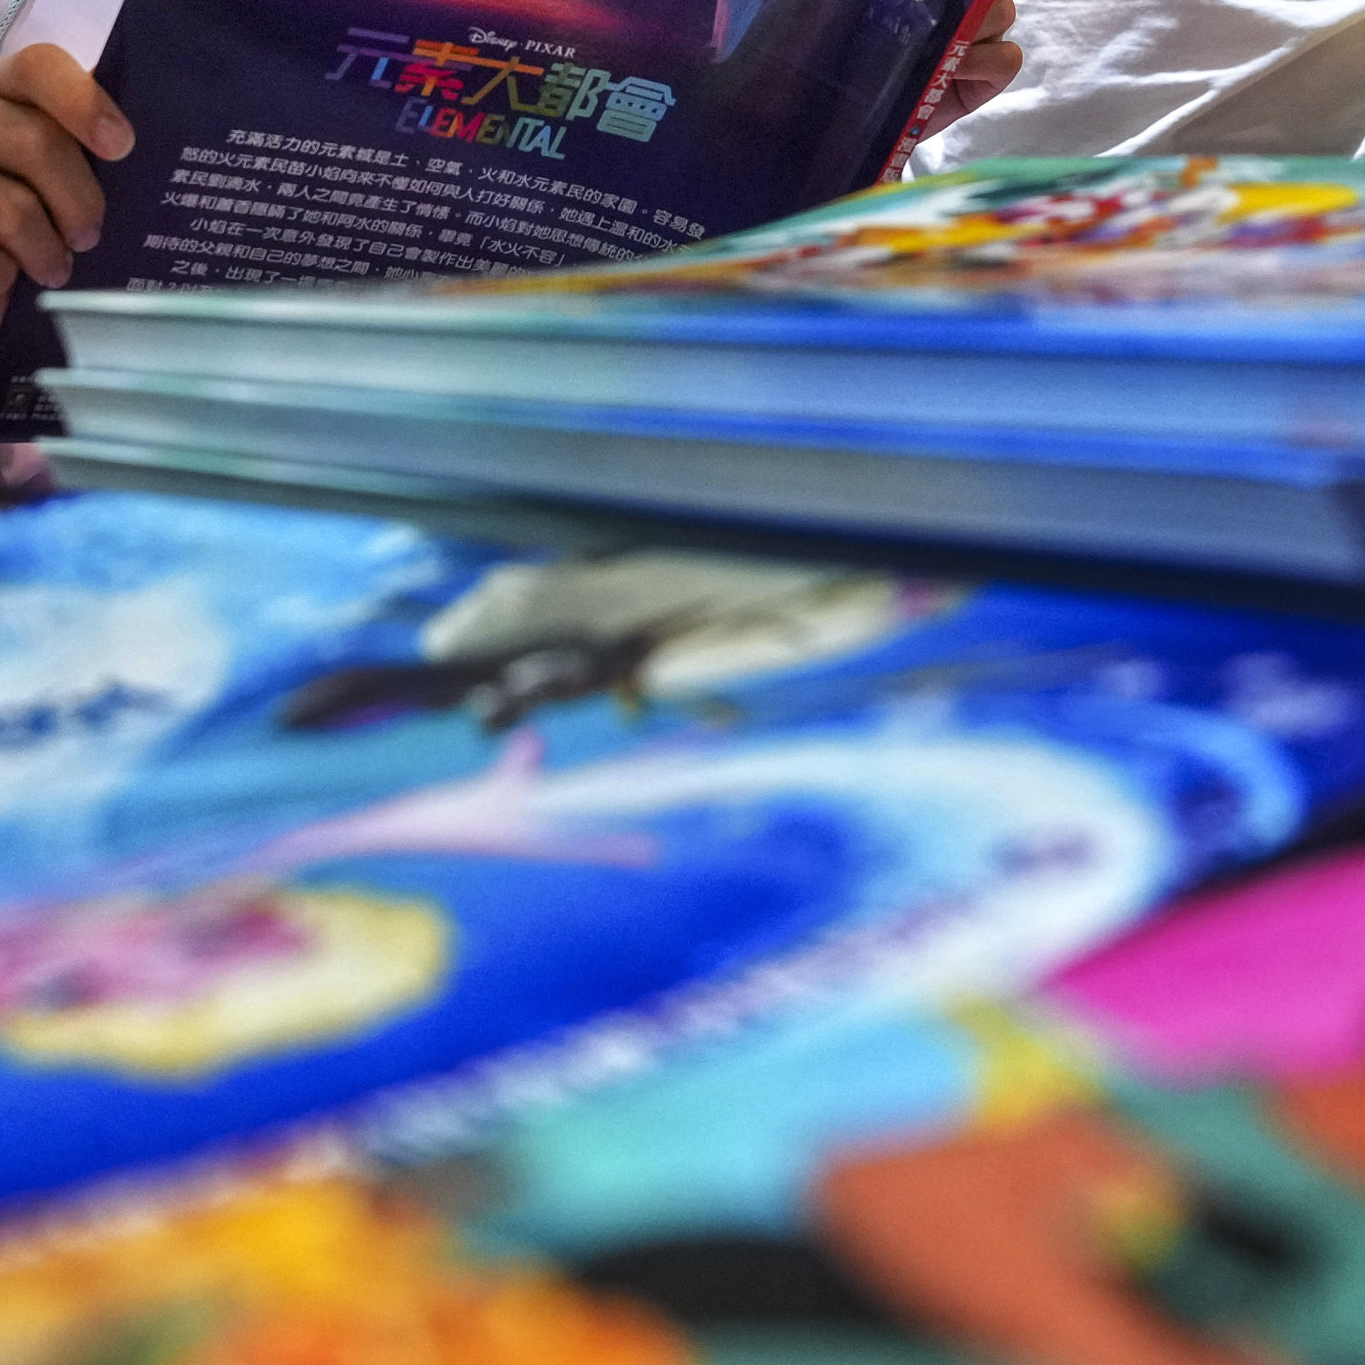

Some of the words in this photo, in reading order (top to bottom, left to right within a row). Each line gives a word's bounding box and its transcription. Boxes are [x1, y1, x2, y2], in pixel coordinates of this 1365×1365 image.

[469, 26, 518, 52] Disney
[524, 40, 576, 58] PIXAR
[324, 27, 677, 143] 元素大都會
[395, 96, 567, 161] ELEMENTAL
